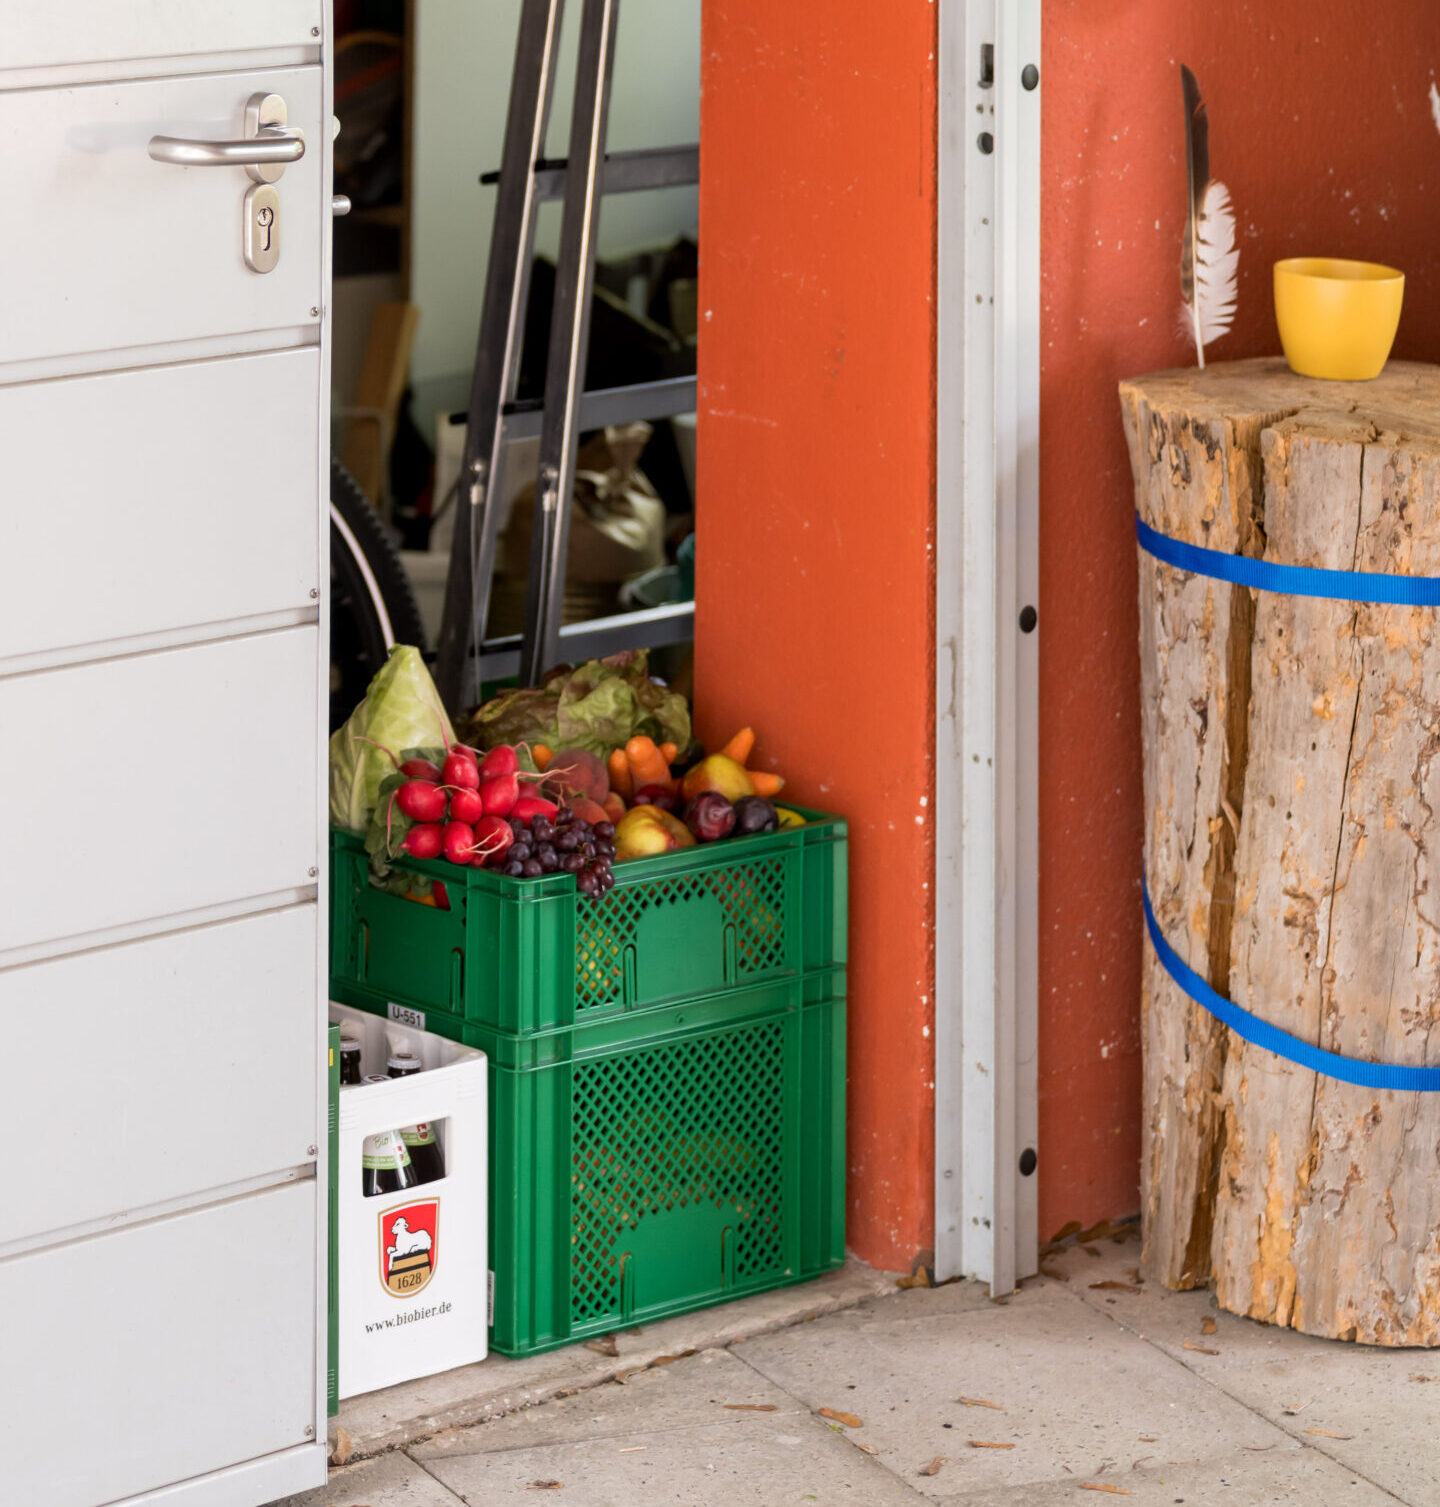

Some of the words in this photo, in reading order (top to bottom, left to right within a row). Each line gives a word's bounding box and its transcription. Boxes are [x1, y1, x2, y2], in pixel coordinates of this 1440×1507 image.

[392, 1005, 421, 1027] U-551
[397, 1271, 422, 1290] 1628
[365, 1301, 452, 1334] www.biobier.de
